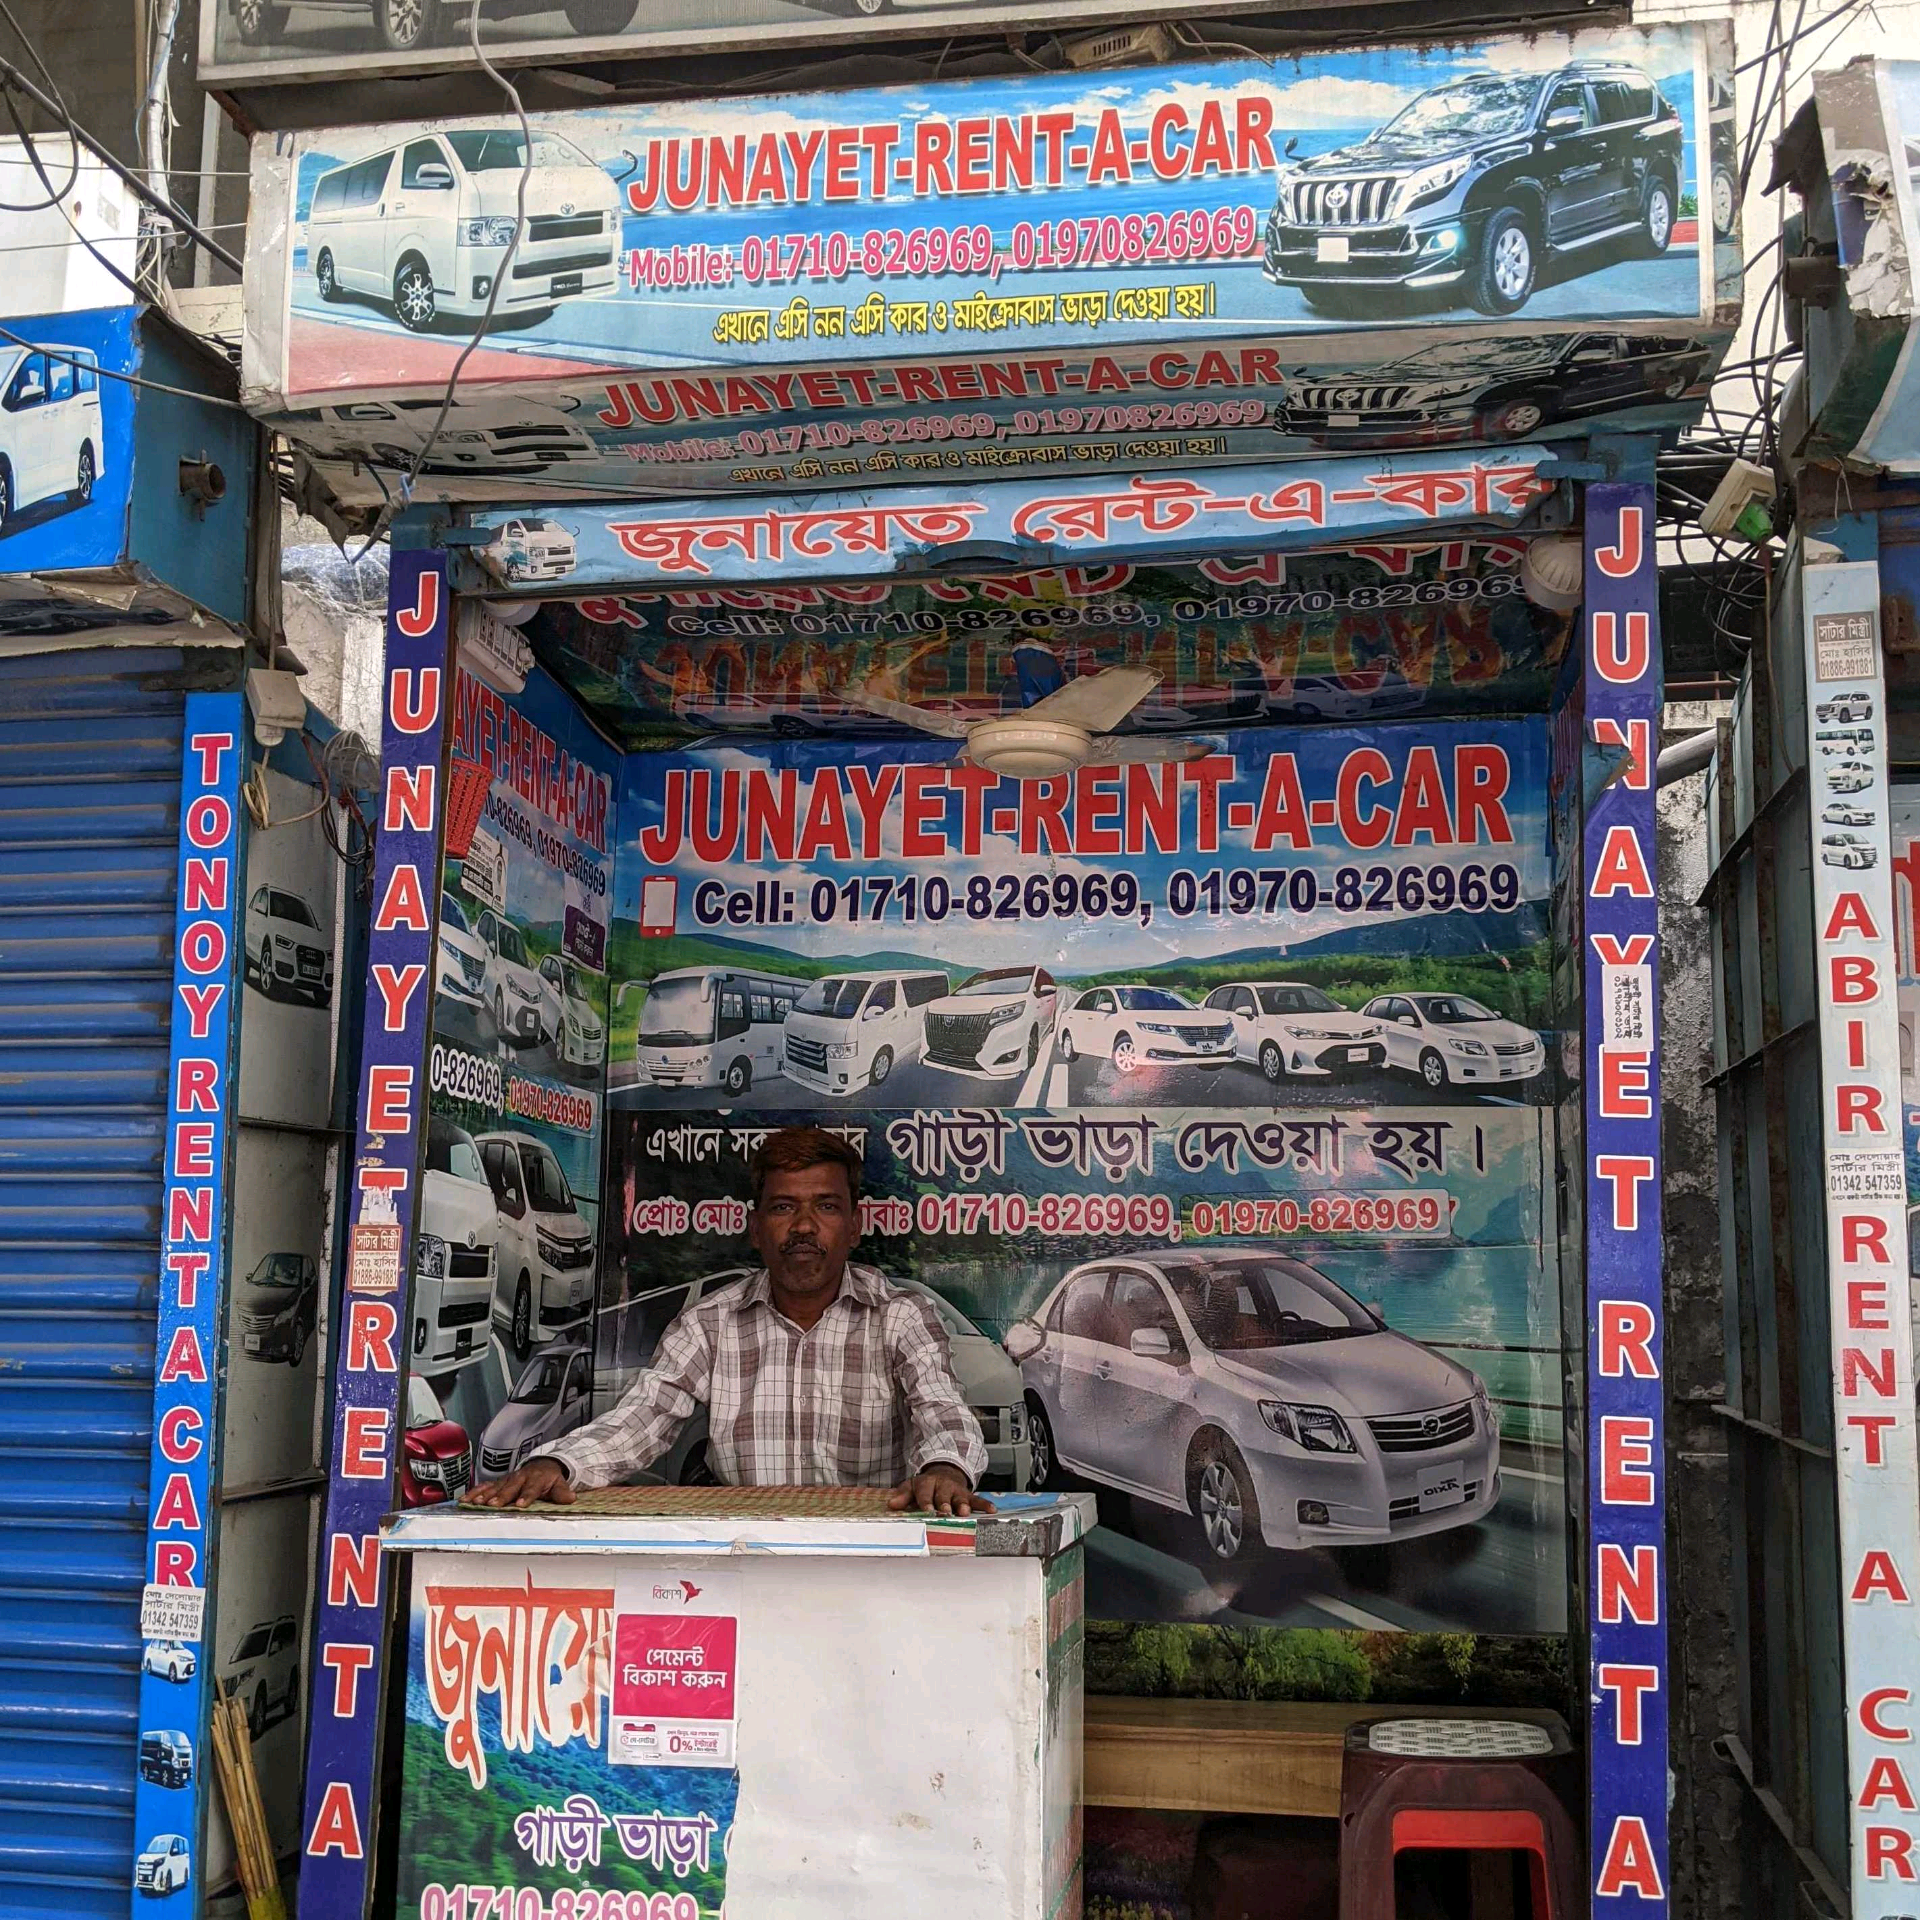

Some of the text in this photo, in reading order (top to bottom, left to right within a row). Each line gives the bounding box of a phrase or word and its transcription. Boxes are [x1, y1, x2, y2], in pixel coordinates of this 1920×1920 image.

[626, 97, 1277, 213] JUNAYET-RENT-A-CAR
[630, 204, 1256, 287] Mobile: 01710-826969, 01970826969
[713, 310, 770, 343] এখানে
[774, 296, 809, 339] এসি
[812, 306, 846, 337] নন
[850, 291, 885, 335] এসি
[890, 302, 929, 333] কার
[932, 301, 947, 330] ও
[952, 290, 1056, 331] মাইক্রোবাস
[1060, 290, 1109, 328] ভাড়া
[1112, 286, 1171, 322] দেওয়া
[596, 347, 1286, 428] JUNAYET-RENT-A-CAR
[622, 400, 1266, 461] Mobile: 01710-826969, 01970826969
[729, 465, 786, 483] এখানে
[788, 456, 824, 481] এসি
[825, 458, 861, 476] নন
[863, 450, 899, 476] এসি
[901, 452, 941, 472] কার
[944, 452, 963, 469] ও
[1071, 443, 1120, 463] ভাড়া
[605, 500, 989, 577] জুনায়েত
[667, 615, 786, 634] Cell:
[793, 600, 1162, 637] 01710-826969,
[453, 665, 607, 854] AYET-RENT-A-CAR
[484, 790, 537, 858] 10-826969,
[537, 828, 606, 897] 01970-826969
[639, 744, 1514, 865] JUNAYET-RENT-A-CAR
[178, 733, 232, 1037] TONOY
[693, 861, 1521, 930] Cell: 01710-826969, 01970-826969
[1822, 892, 1885, 1135] ABIR
[430, 1044, 593, 1131] 0-826969, 01970-826969
[168, 1058, 220, 1308] RENT
[646, 1123, 724, 1163] এখানে
[1019, 1114, 1160, 1182] ভাড়া
[1177, 1115, 1352, 1174] দেওয়া
[1830, 1174, 1902, 1191] 01342 547359
[692, 1195, 747, 1236] মোঃ
[917, 1192, 1182, 1243] 01710-826969,
[1193, 1198, 1444, 1234] 01970-826969
[353, 1268, 397, 1285] 01886-991881
[160, 1326, 208, 1383] A
[1841, 1215, 1898, 1466] RENT
[154, 1405, 205, 1587] CAR
[322, 1299, 397, 1720] RENT
[1597, 1300, 1660, 1747] RENT
[1852, 1550, 1910, 1602] A
[142, 1610, 199, 1630] 01342 547359
[646, 1646, 705, 1668] পেমেন্ট
[623, 1665, 728, 1689] বিকাশ করুন
[306, 1781, 365, 1861] A
[1858, 1687, 1918, 1880] CAR
[515, 1794, 718, 1878] গাড়ী ভাড়া
[1596, 1812, 1664, 1900] A
